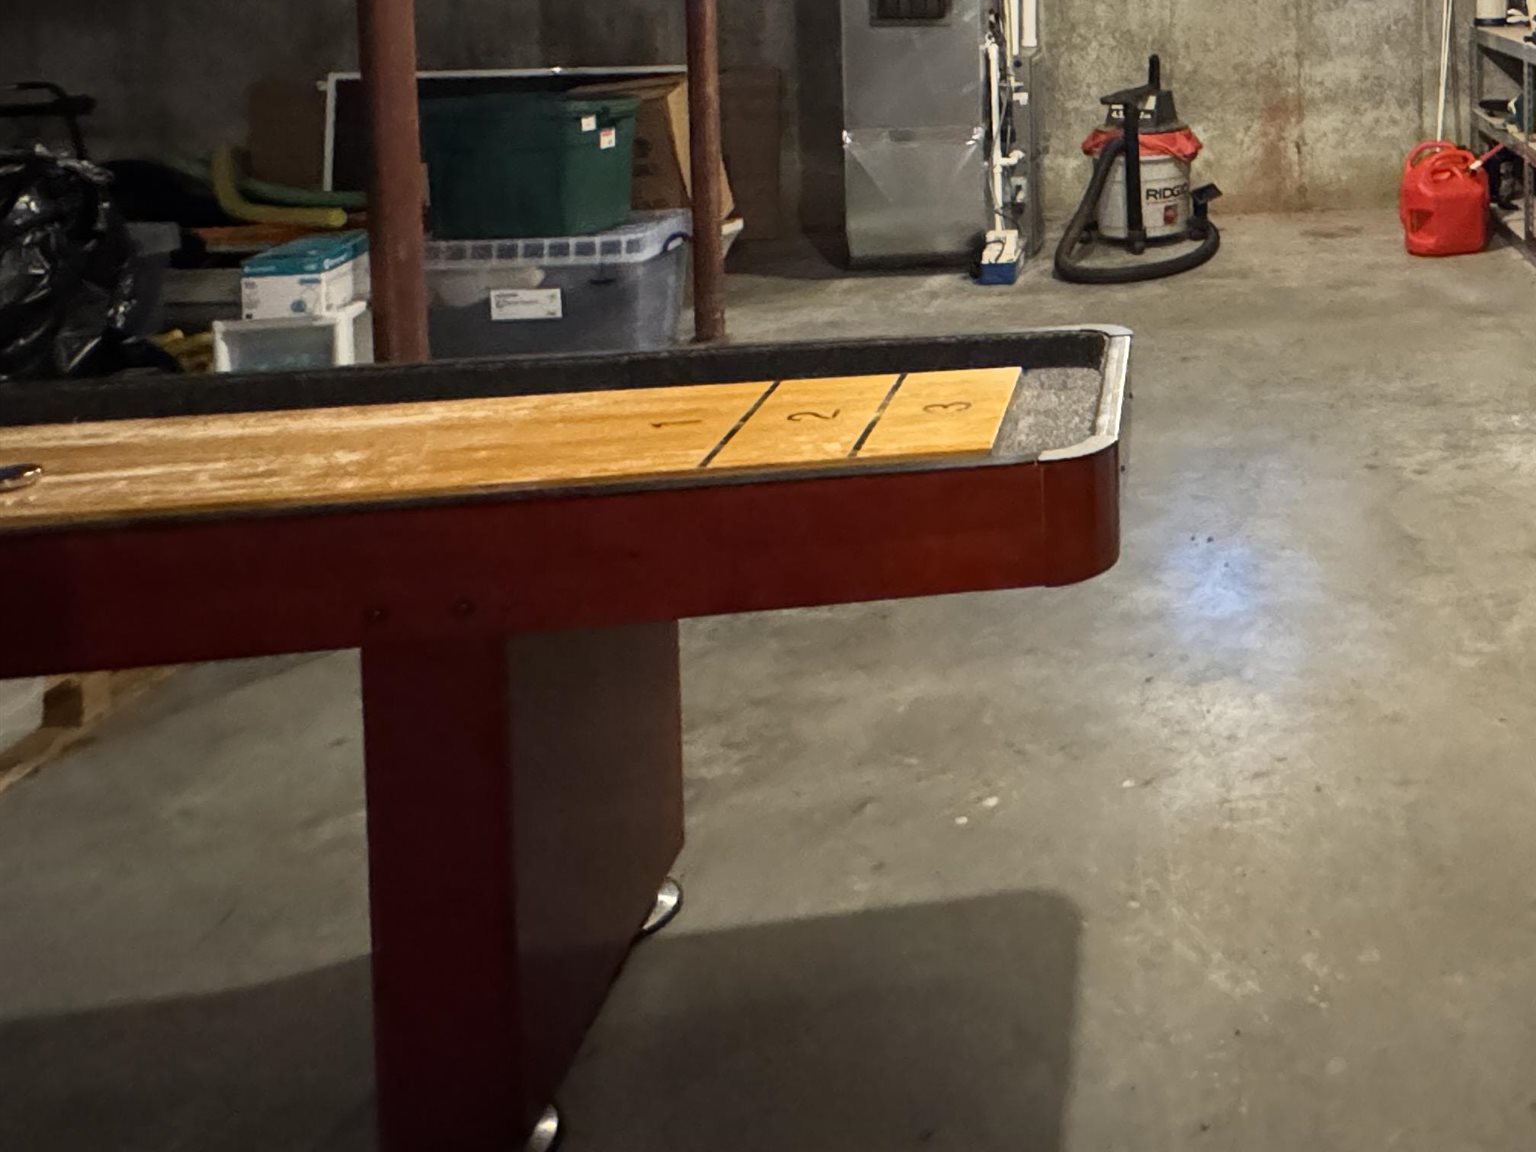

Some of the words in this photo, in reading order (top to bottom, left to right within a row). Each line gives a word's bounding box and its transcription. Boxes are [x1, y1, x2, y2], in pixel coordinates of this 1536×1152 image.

[922, 400, 972, 415] 3
[786, 408, 841, 421] 2
[651, 418, 703, 429] 1
